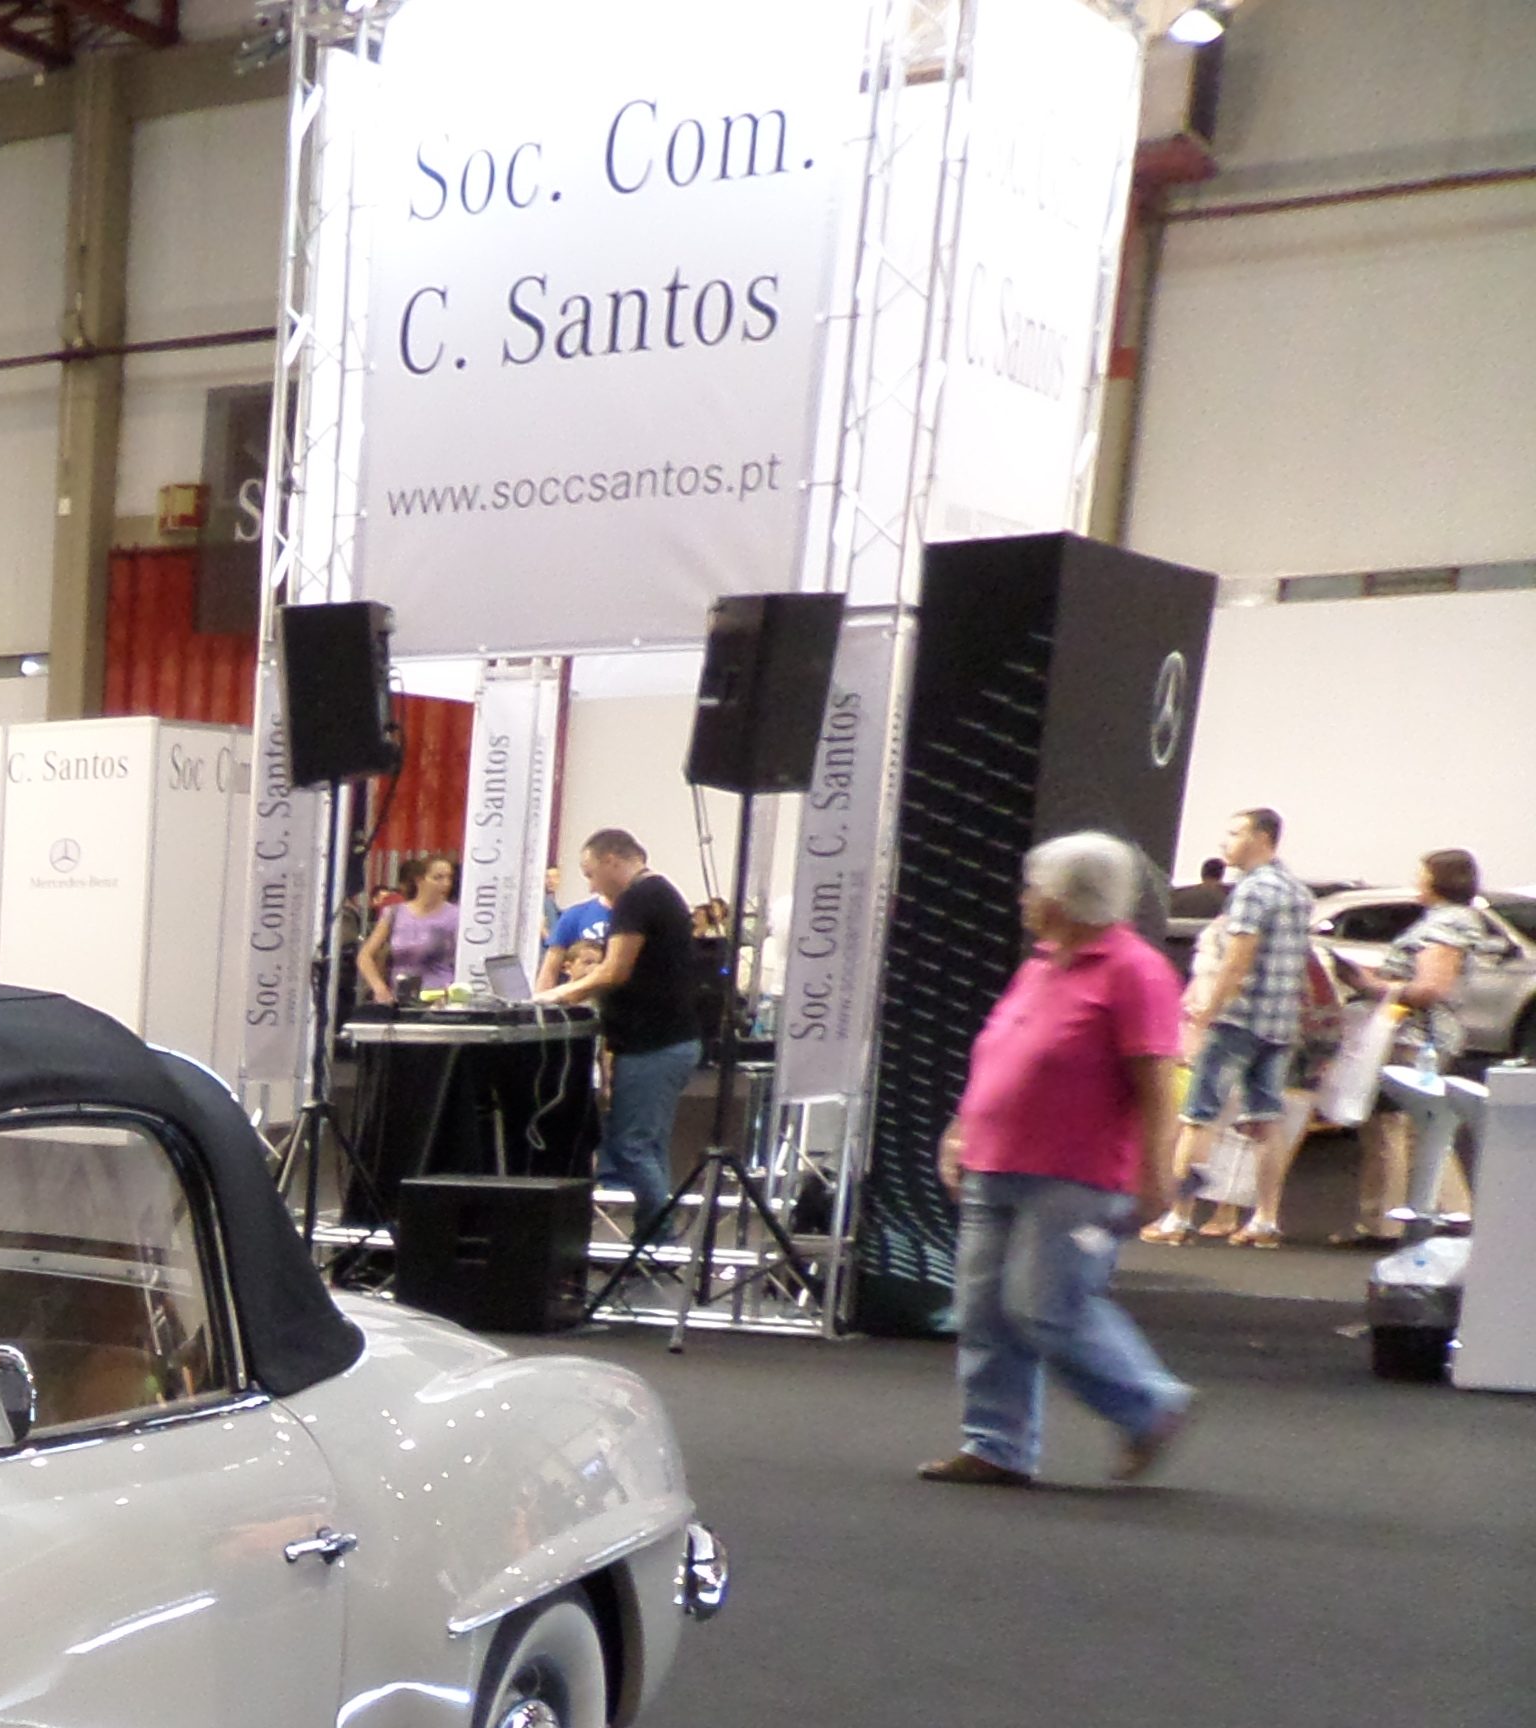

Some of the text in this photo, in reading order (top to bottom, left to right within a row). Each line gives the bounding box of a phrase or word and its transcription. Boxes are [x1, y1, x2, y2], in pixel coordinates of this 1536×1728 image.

[408, 97, 816, 222] Soc. Com.
[399, 267, 781, 376] C. Santos
[387, 452, 781, 517] www.soccsantos.pt
[7, 752, 32, 784] C.
[42, 749, 130, 783] Santos
[475, 733, 511, 829] Santos
[255, 830, 290, 862] C.
[789, 690, 862, 1042] Soc. Com. C. Santos
[251, 872, 287, 952] Com.
[464, 872, 498, 946] Com.
[246, 963, 281, 1027] Soc.
